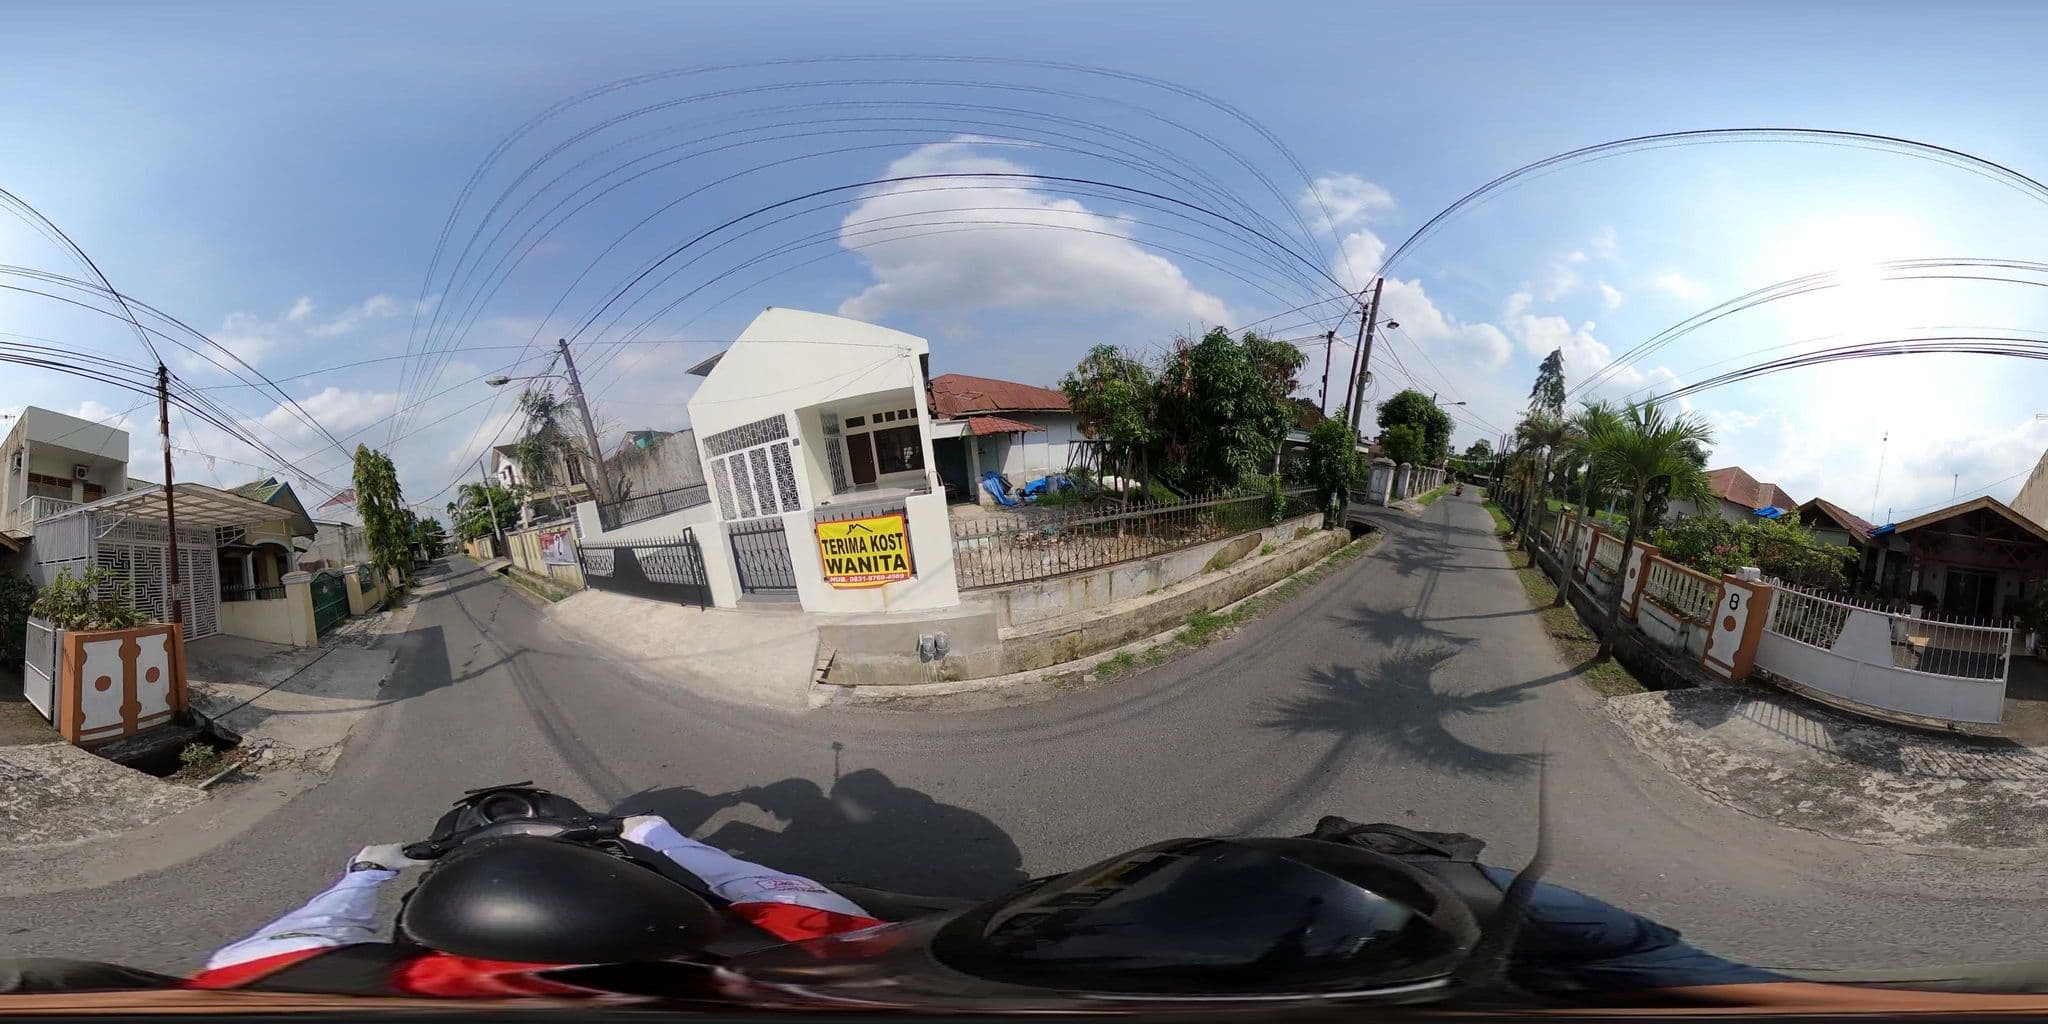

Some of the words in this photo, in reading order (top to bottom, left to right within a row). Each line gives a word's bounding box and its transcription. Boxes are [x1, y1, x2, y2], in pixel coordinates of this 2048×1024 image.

[822, 537, 867, 555] TERIMA
[870, 533, 903, 552] KOST
[825, 554, 907, 574] WANITA
[1729, 593, 1740, 610] 8
